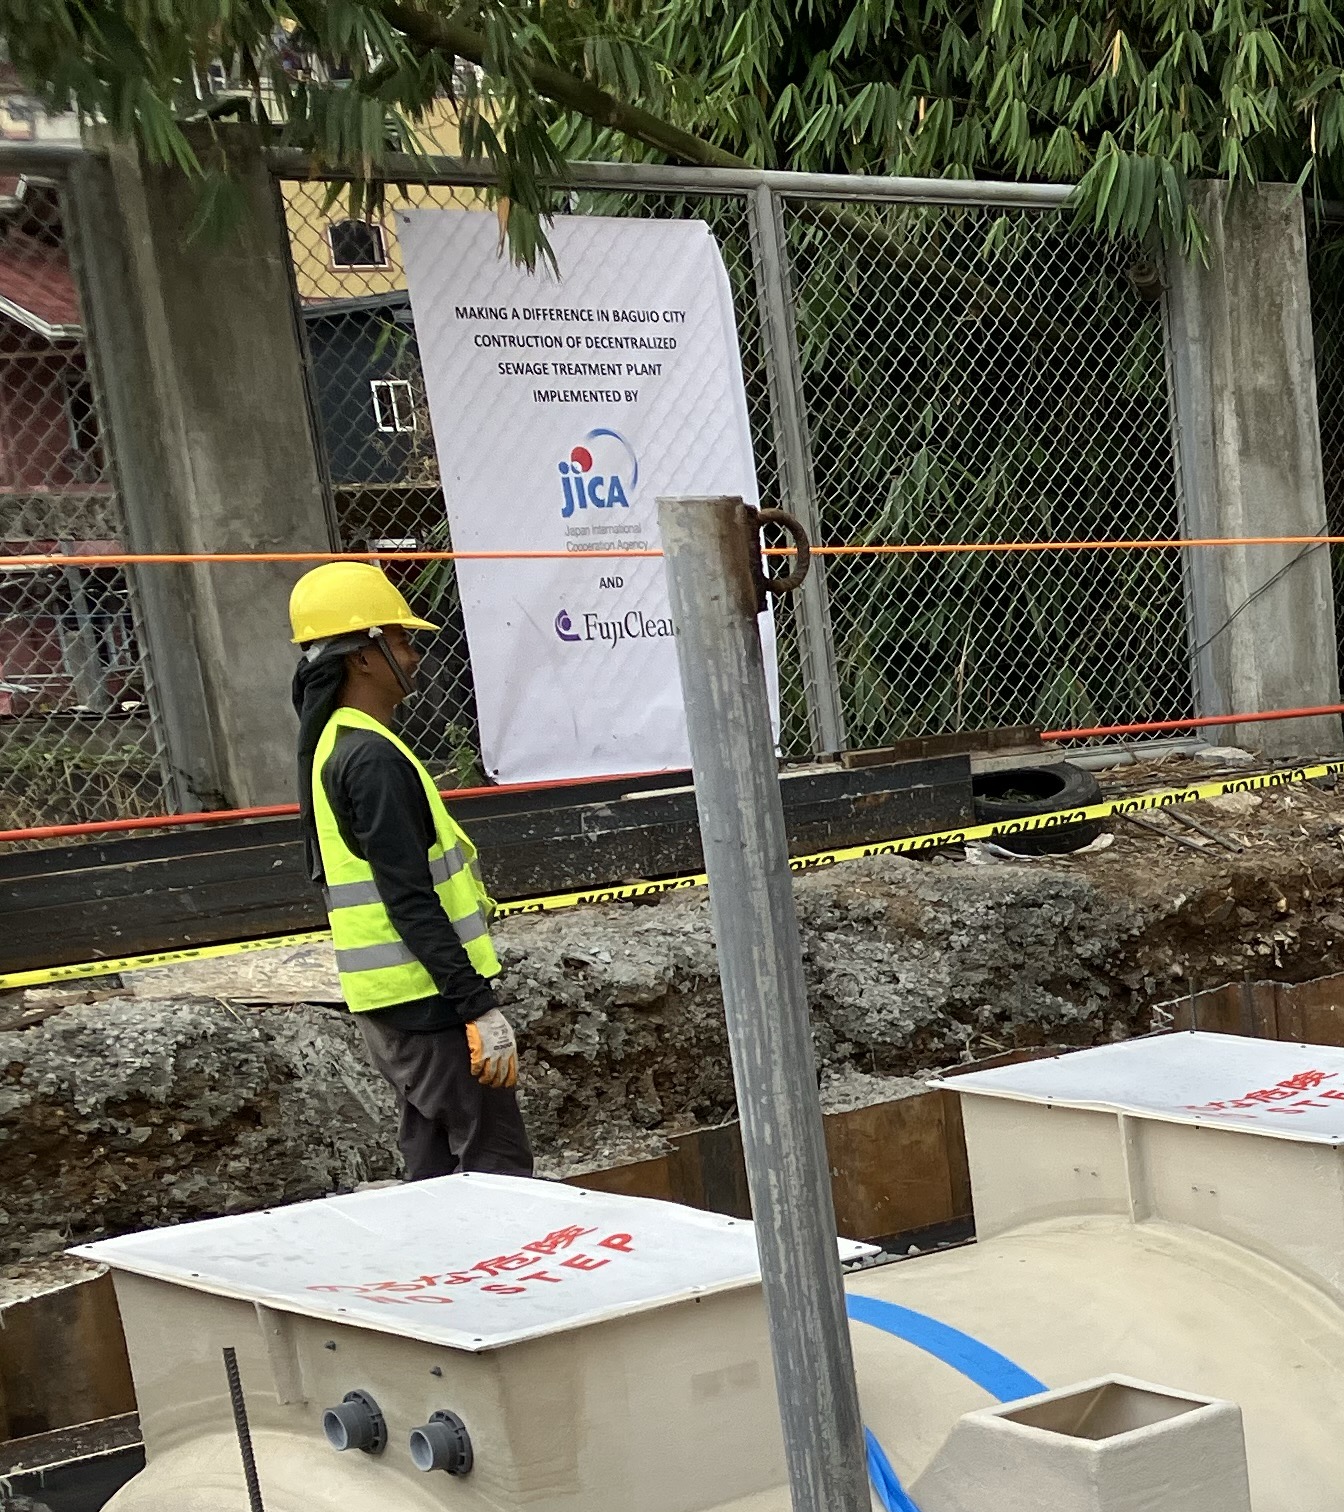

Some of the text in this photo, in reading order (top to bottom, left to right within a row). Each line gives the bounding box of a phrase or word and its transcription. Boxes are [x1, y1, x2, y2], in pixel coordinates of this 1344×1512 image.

[455, 306, 686, 323] MAKING A DIFFERENCE IN BAGUIO CITY
[474, 334, 677, 350] CONTRUCTION OF DECENTRALIZED
[498, 362, 662, 376] SEWAGE TREATMENT PLANT
[533, 389, 639, 403] IMPLEMENTED BY
[565, 523, 642, 538] Japan International
[566, 539, 648, 552] Cooperation Agency
[599, 576, 624, 589] AND
[991, 811, 1087, 836] CAUTION
[1111, 789, 1200, 815] CAUTION
[1222, 767, 1306, 795] CAUTION
[480, 1232, 636, 1295] STEP
